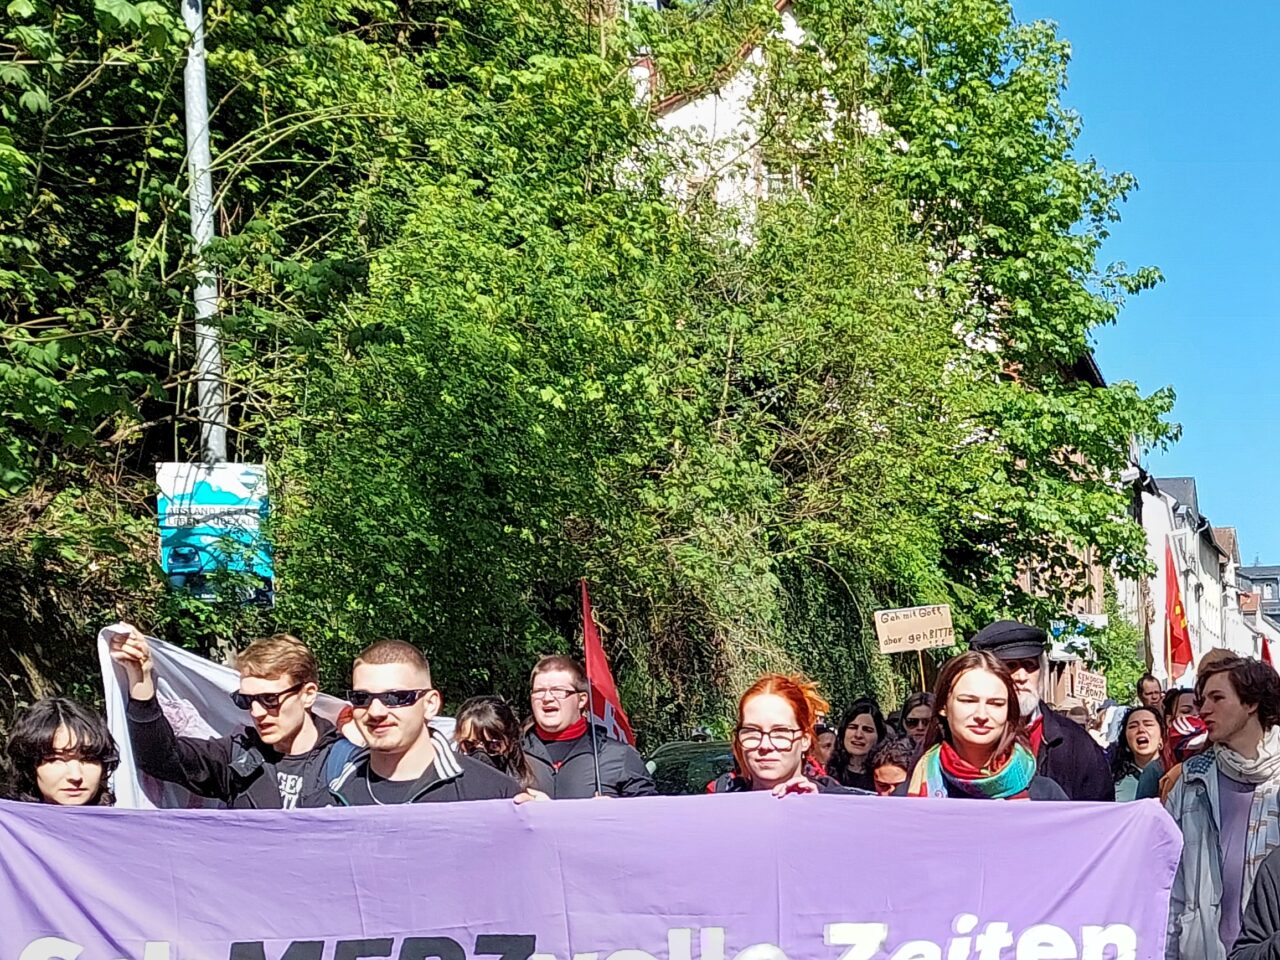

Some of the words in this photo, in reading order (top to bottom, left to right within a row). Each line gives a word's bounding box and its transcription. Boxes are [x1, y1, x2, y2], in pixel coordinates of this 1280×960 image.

[881, 612, 900, 623] Geh
[908, 632, 929, 644] geh
[929, 627, 953, 639] BITTE
